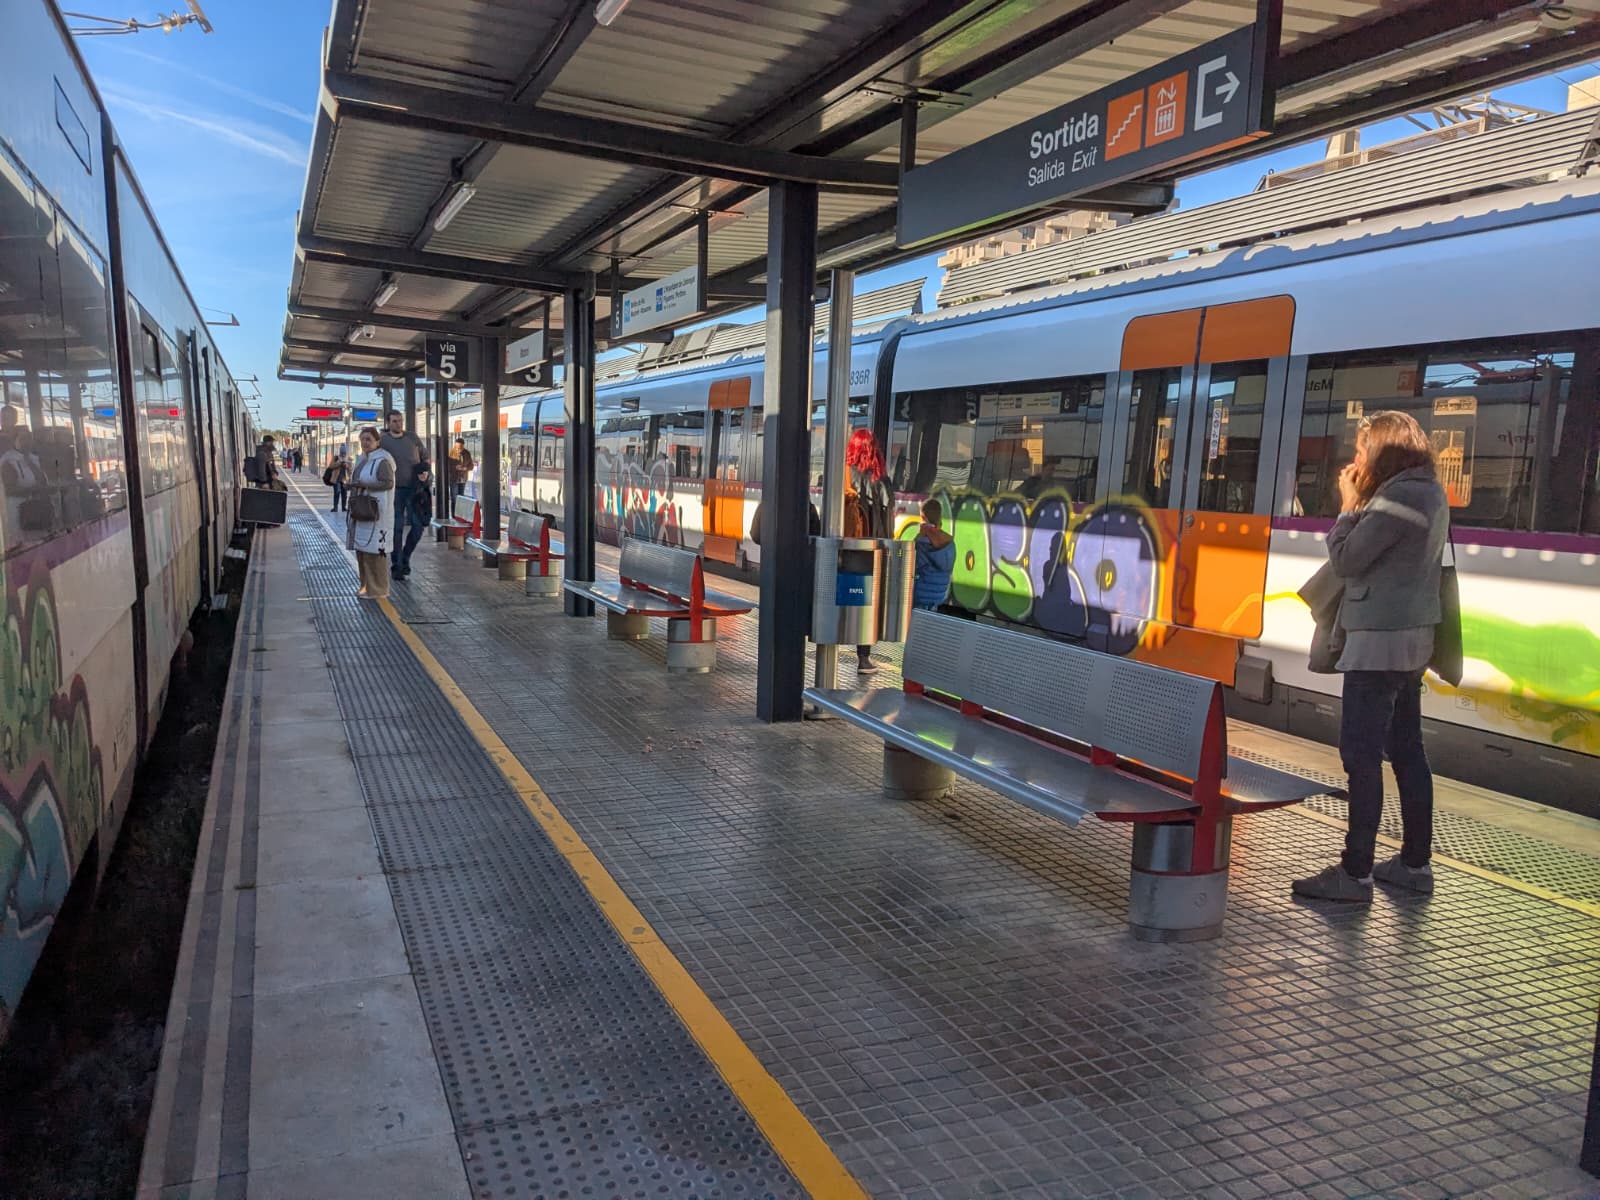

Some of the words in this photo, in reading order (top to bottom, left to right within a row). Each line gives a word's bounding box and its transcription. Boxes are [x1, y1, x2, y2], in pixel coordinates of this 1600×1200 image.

[1030, 112, 1099, 159] Sortida
[1028, 159, 1065, 187] Salida
[1072, 146, 1098, 172] Exit
[440, 342, 456, 353] via
[440, 354, 456, 379] 5
[525, 365, 541, 383] 3
